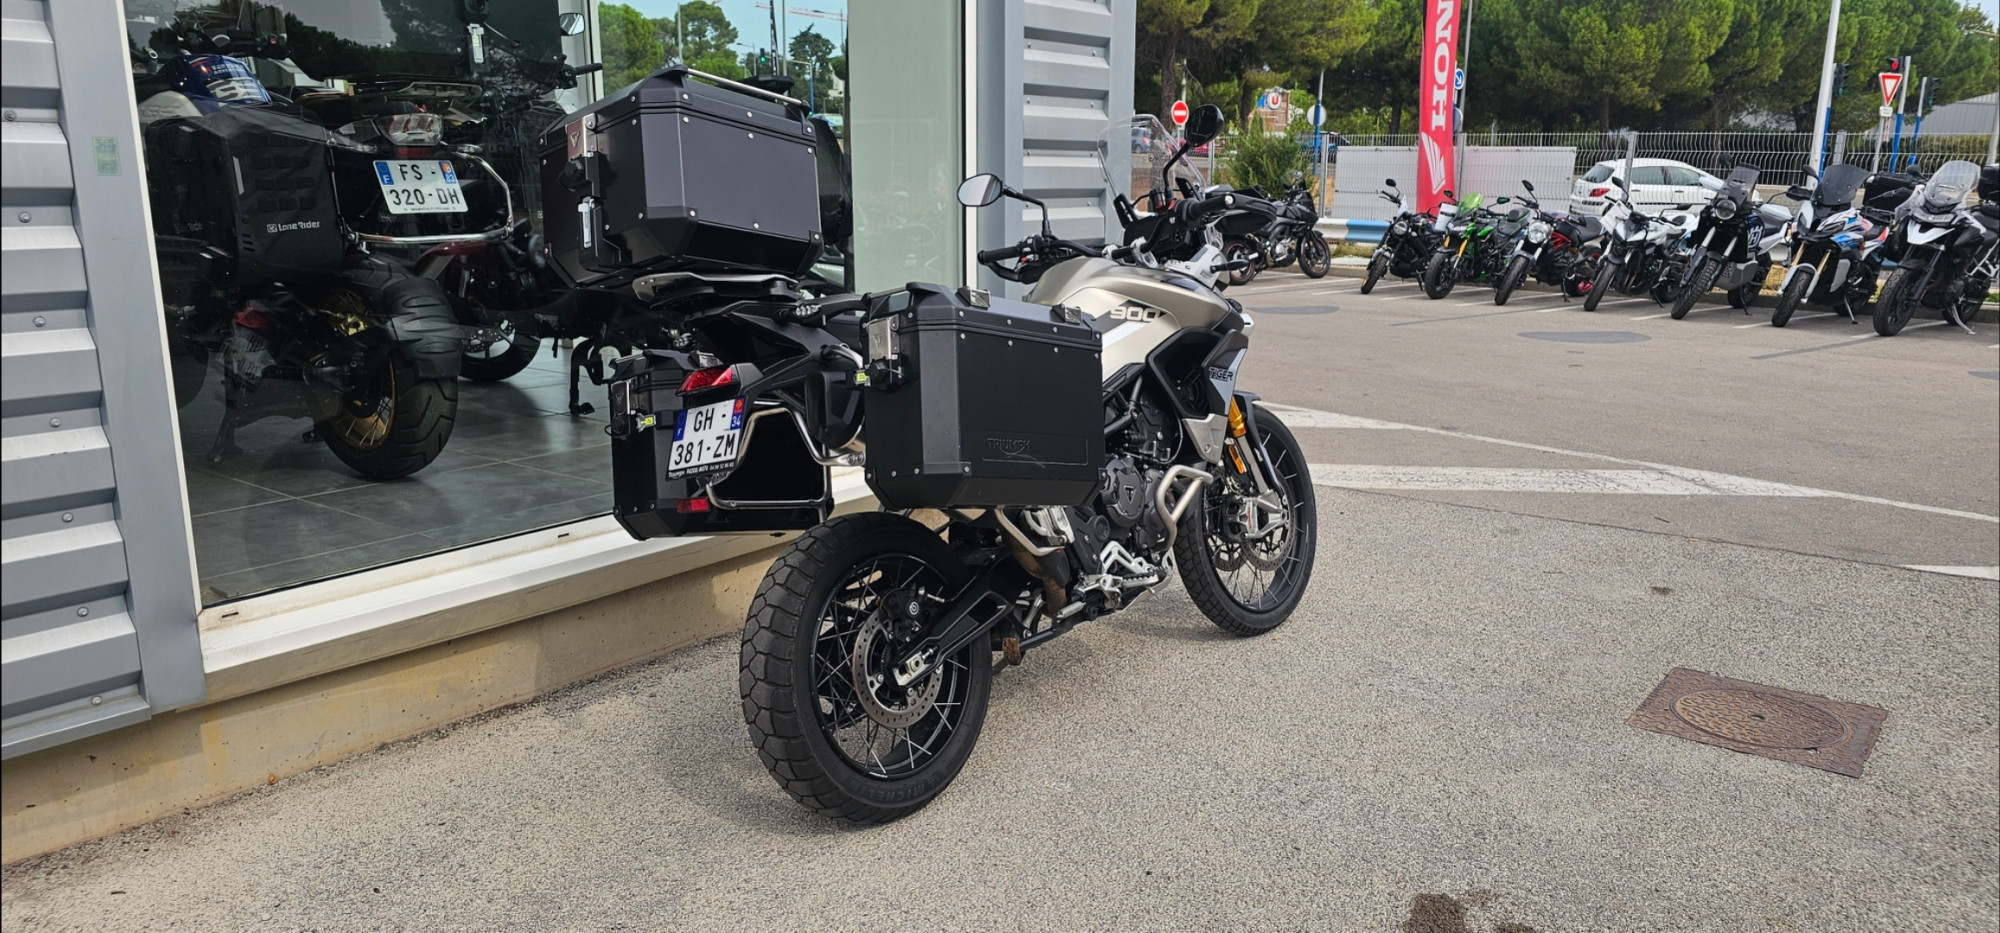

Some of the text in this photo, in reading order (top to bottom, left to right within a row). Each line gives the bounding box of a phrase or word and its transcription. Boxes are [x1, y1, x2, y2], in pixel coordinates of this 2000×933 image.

[1271, 96, 1279, 105] U
[382, 174, 390, 184] F
[398, 164, 423, 181] FS
[389, 188, 460, 206] 320-DH
[278, 221, 320, 232] Lone Rider
[1110, 306, 1160, 322] 900
[1209, 366, 1233, 382] TIGER
[693, 407, 715, 433] GH
[731, 415, 741, 427] 34
[677, 428, 682, 436] F
[674, 433, 736, 466] 381-ZM
